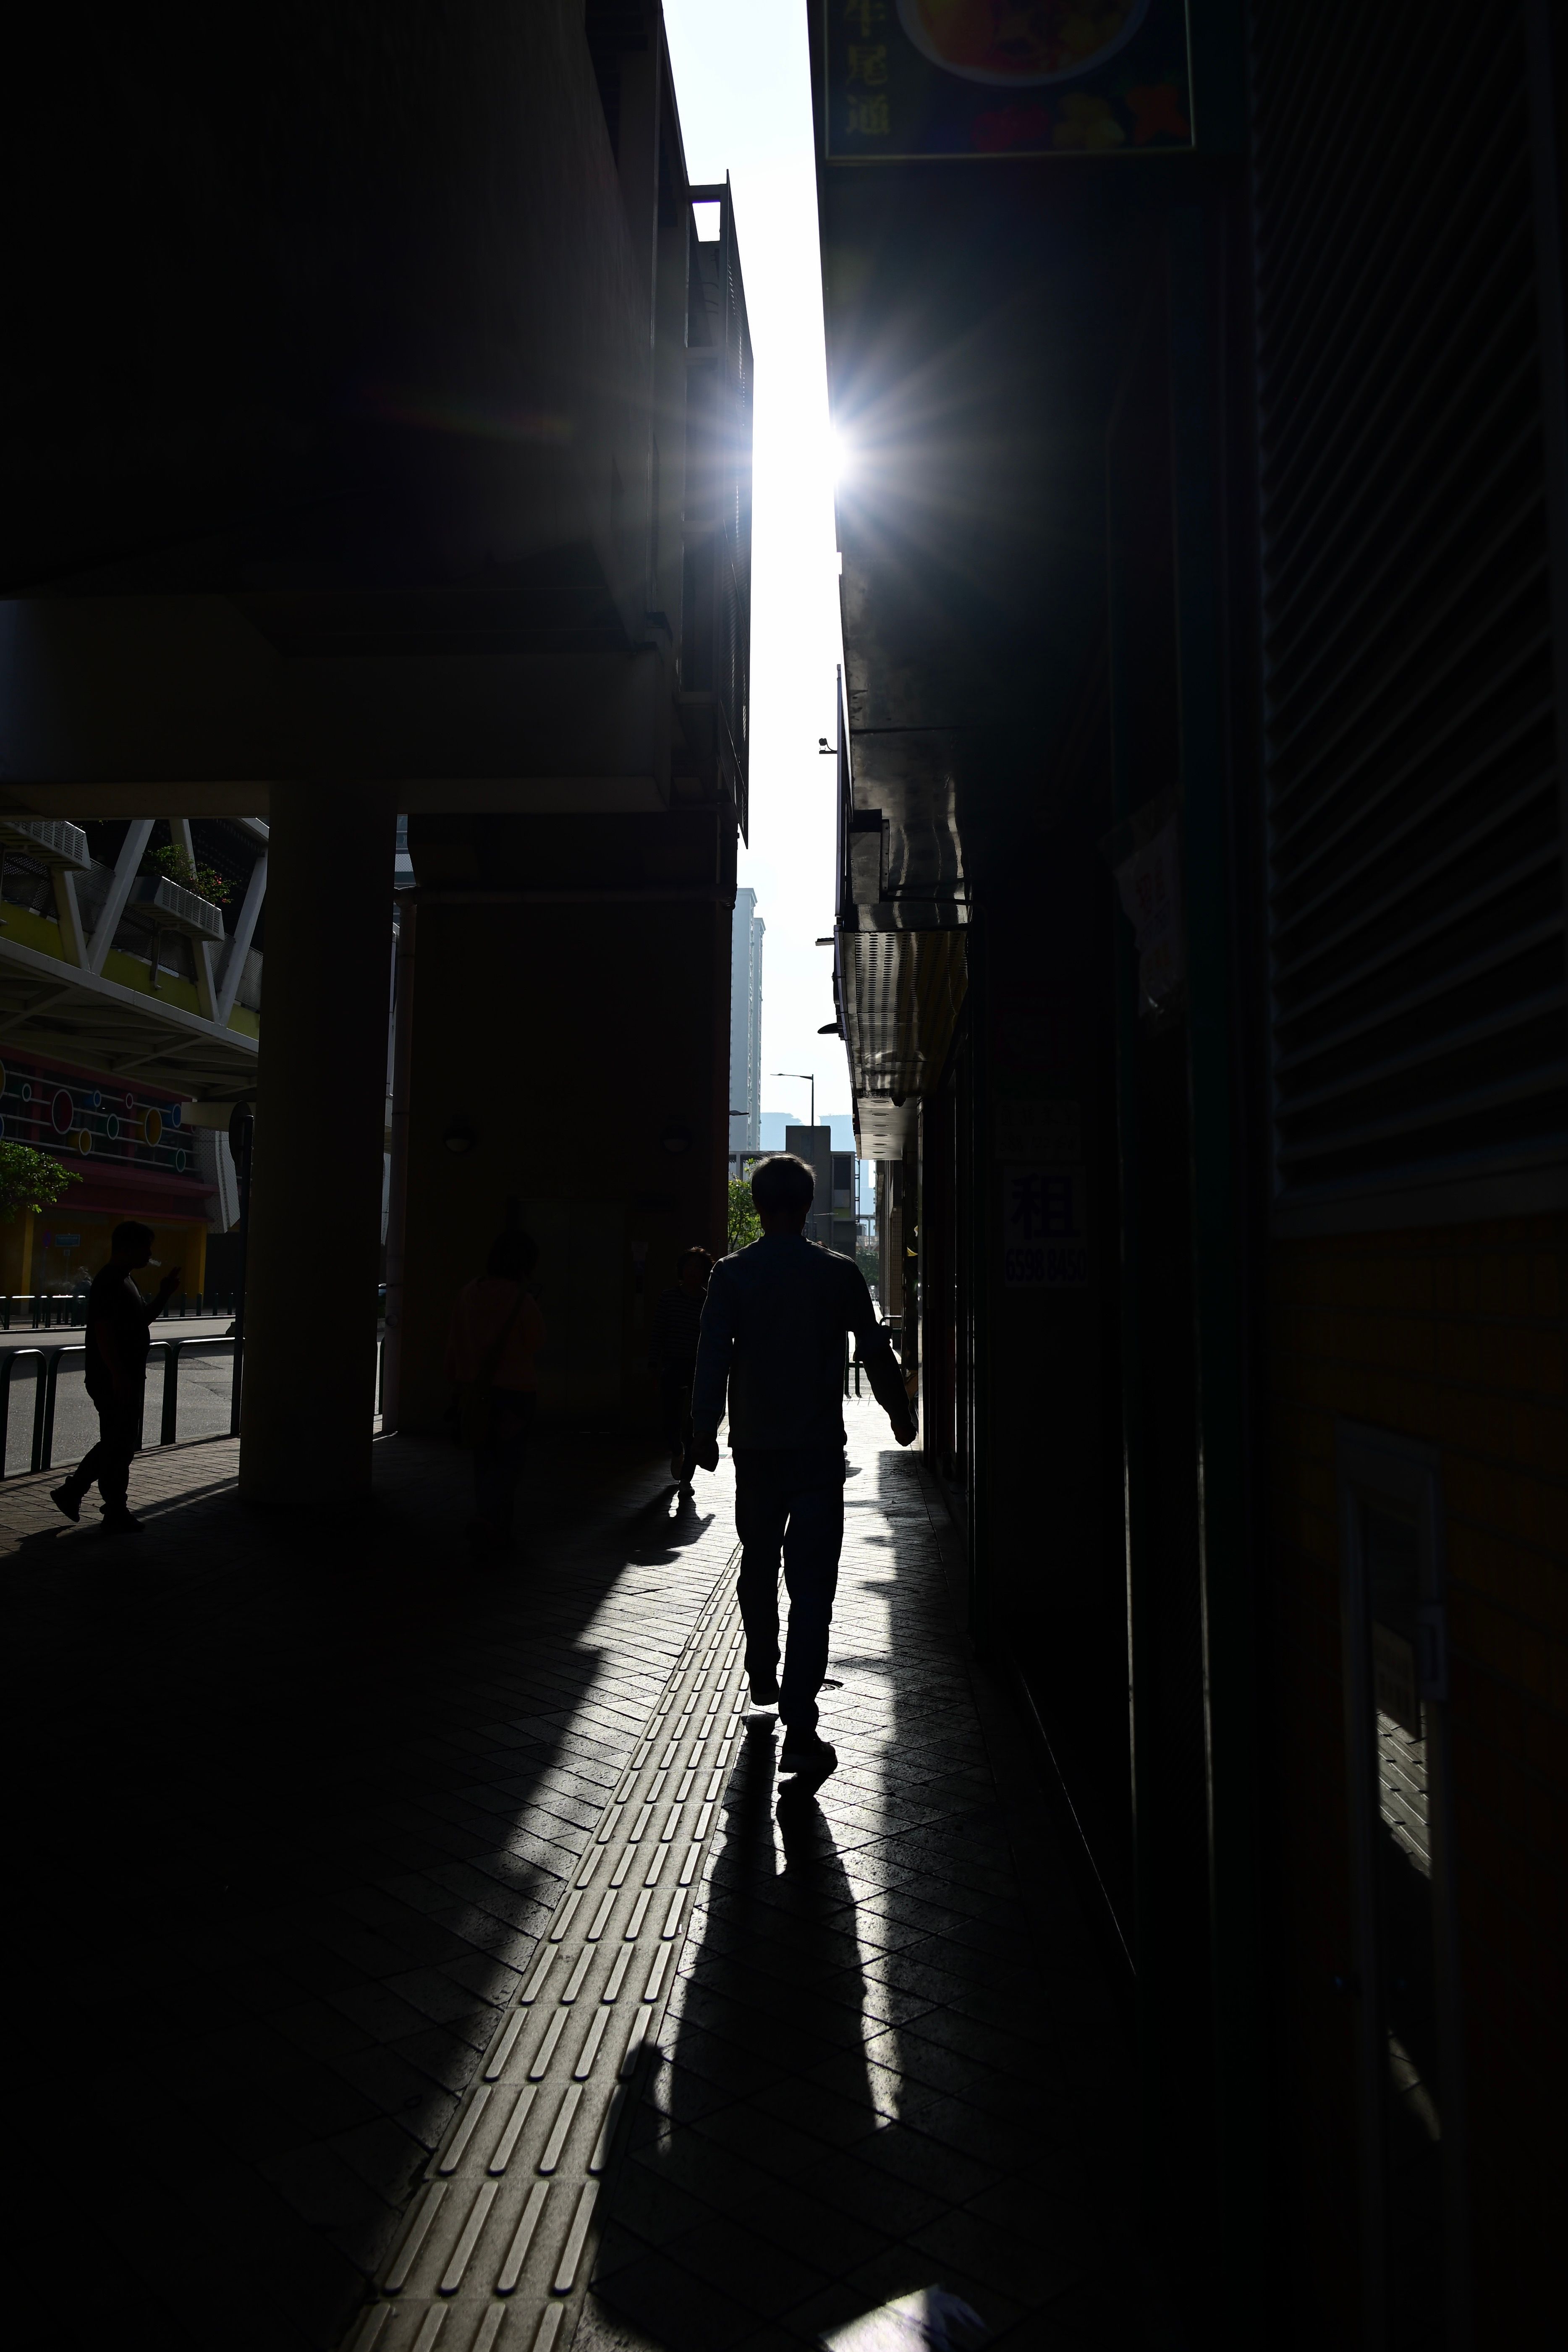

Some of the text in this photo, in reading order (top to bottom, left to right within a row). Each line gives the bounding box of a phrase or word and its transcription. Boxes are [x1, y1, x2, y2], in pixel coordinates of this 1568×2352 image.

[1010, 1172, 1081, 1240] 租
[1006, 1248, 1087, 1282] 6598 8450
